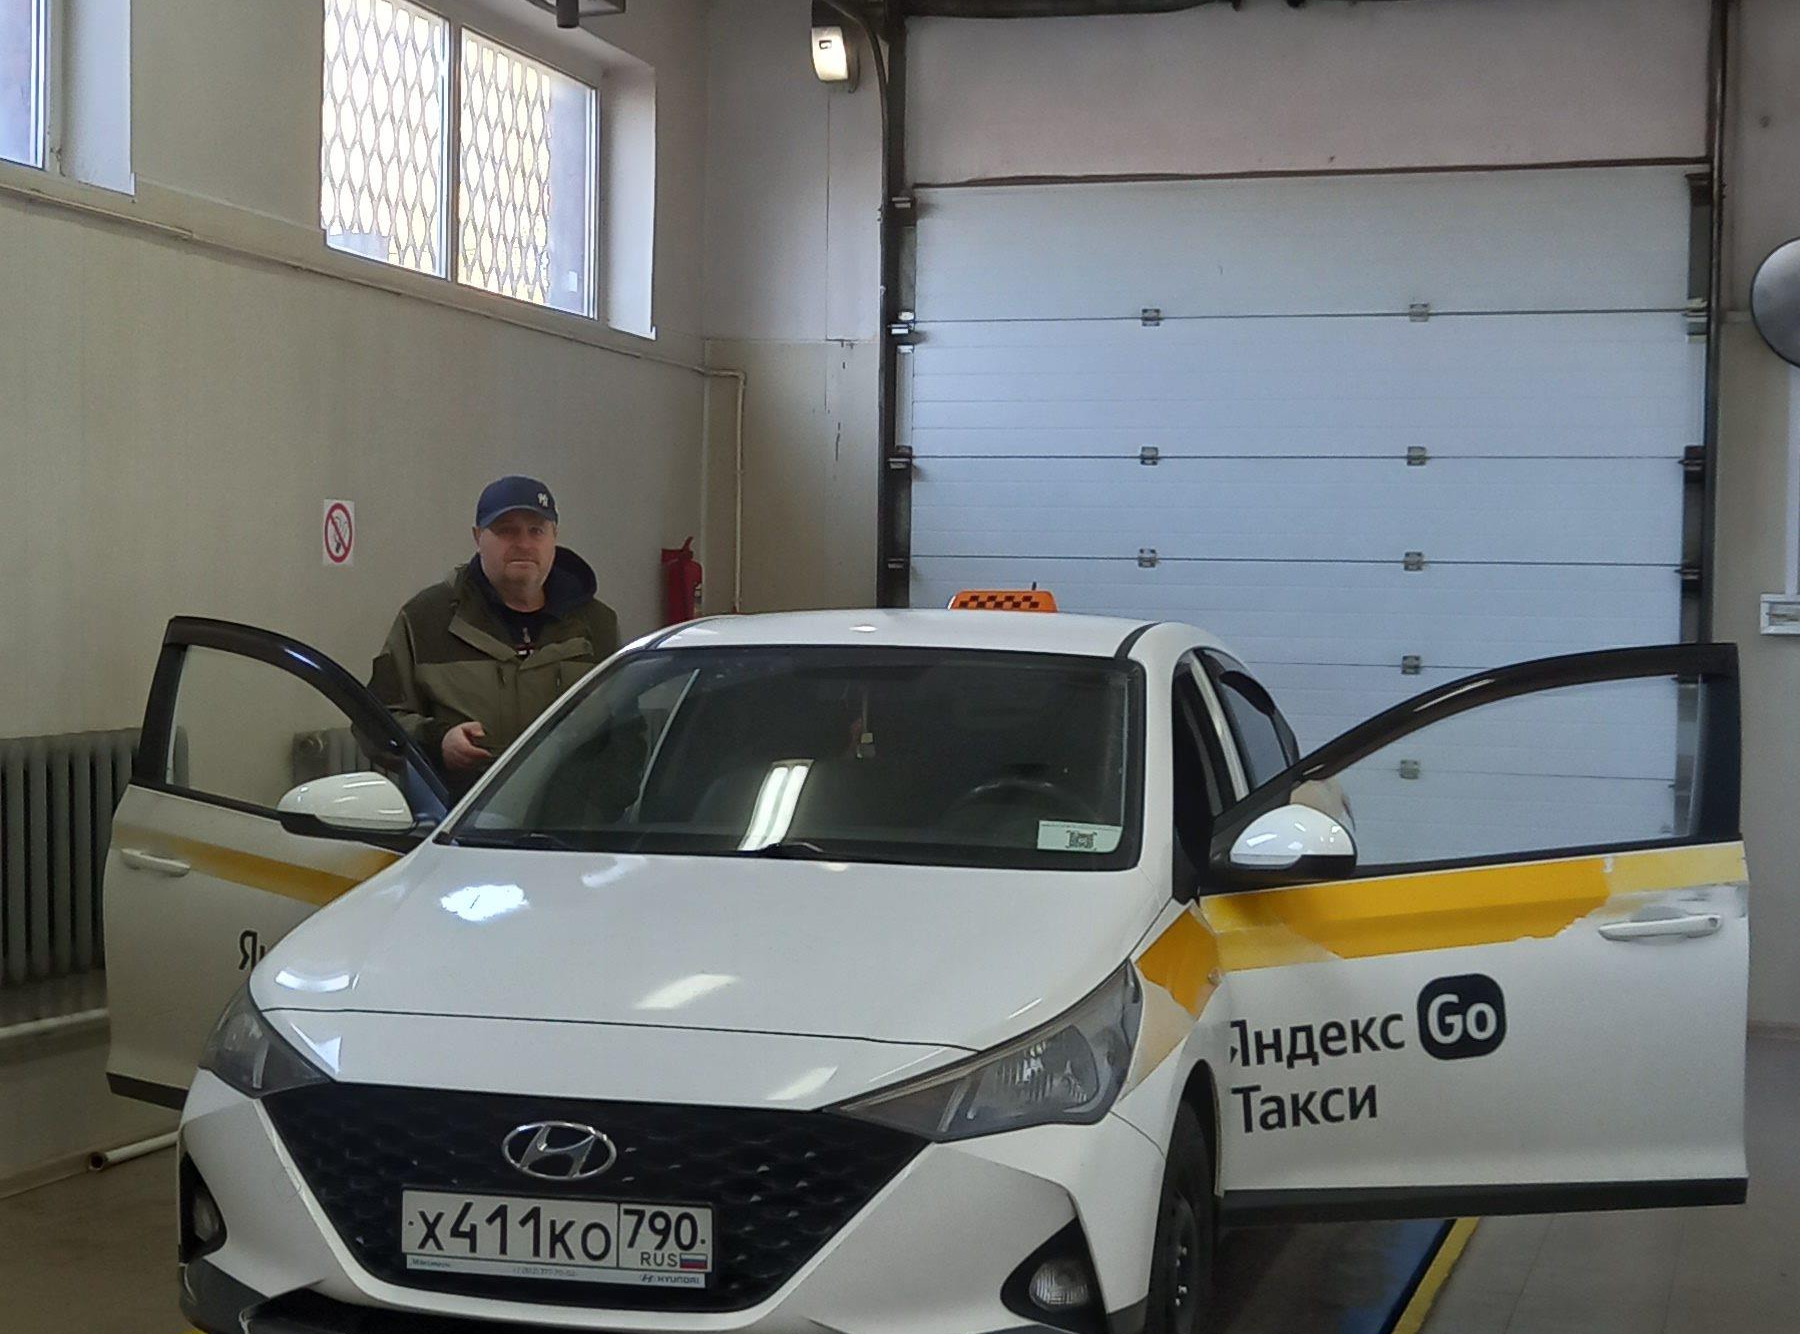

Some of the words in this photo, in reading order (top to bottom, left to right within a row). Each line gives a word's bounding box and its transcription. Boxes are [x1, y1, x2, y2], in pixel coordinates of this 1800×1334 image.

[1427, 994, 1498, 1045] Go
[1231, 1084, 1378, 1134] Такси
[622, 1208, 699, 1251] 790
[640, 1251, 678, 1267] RUS
